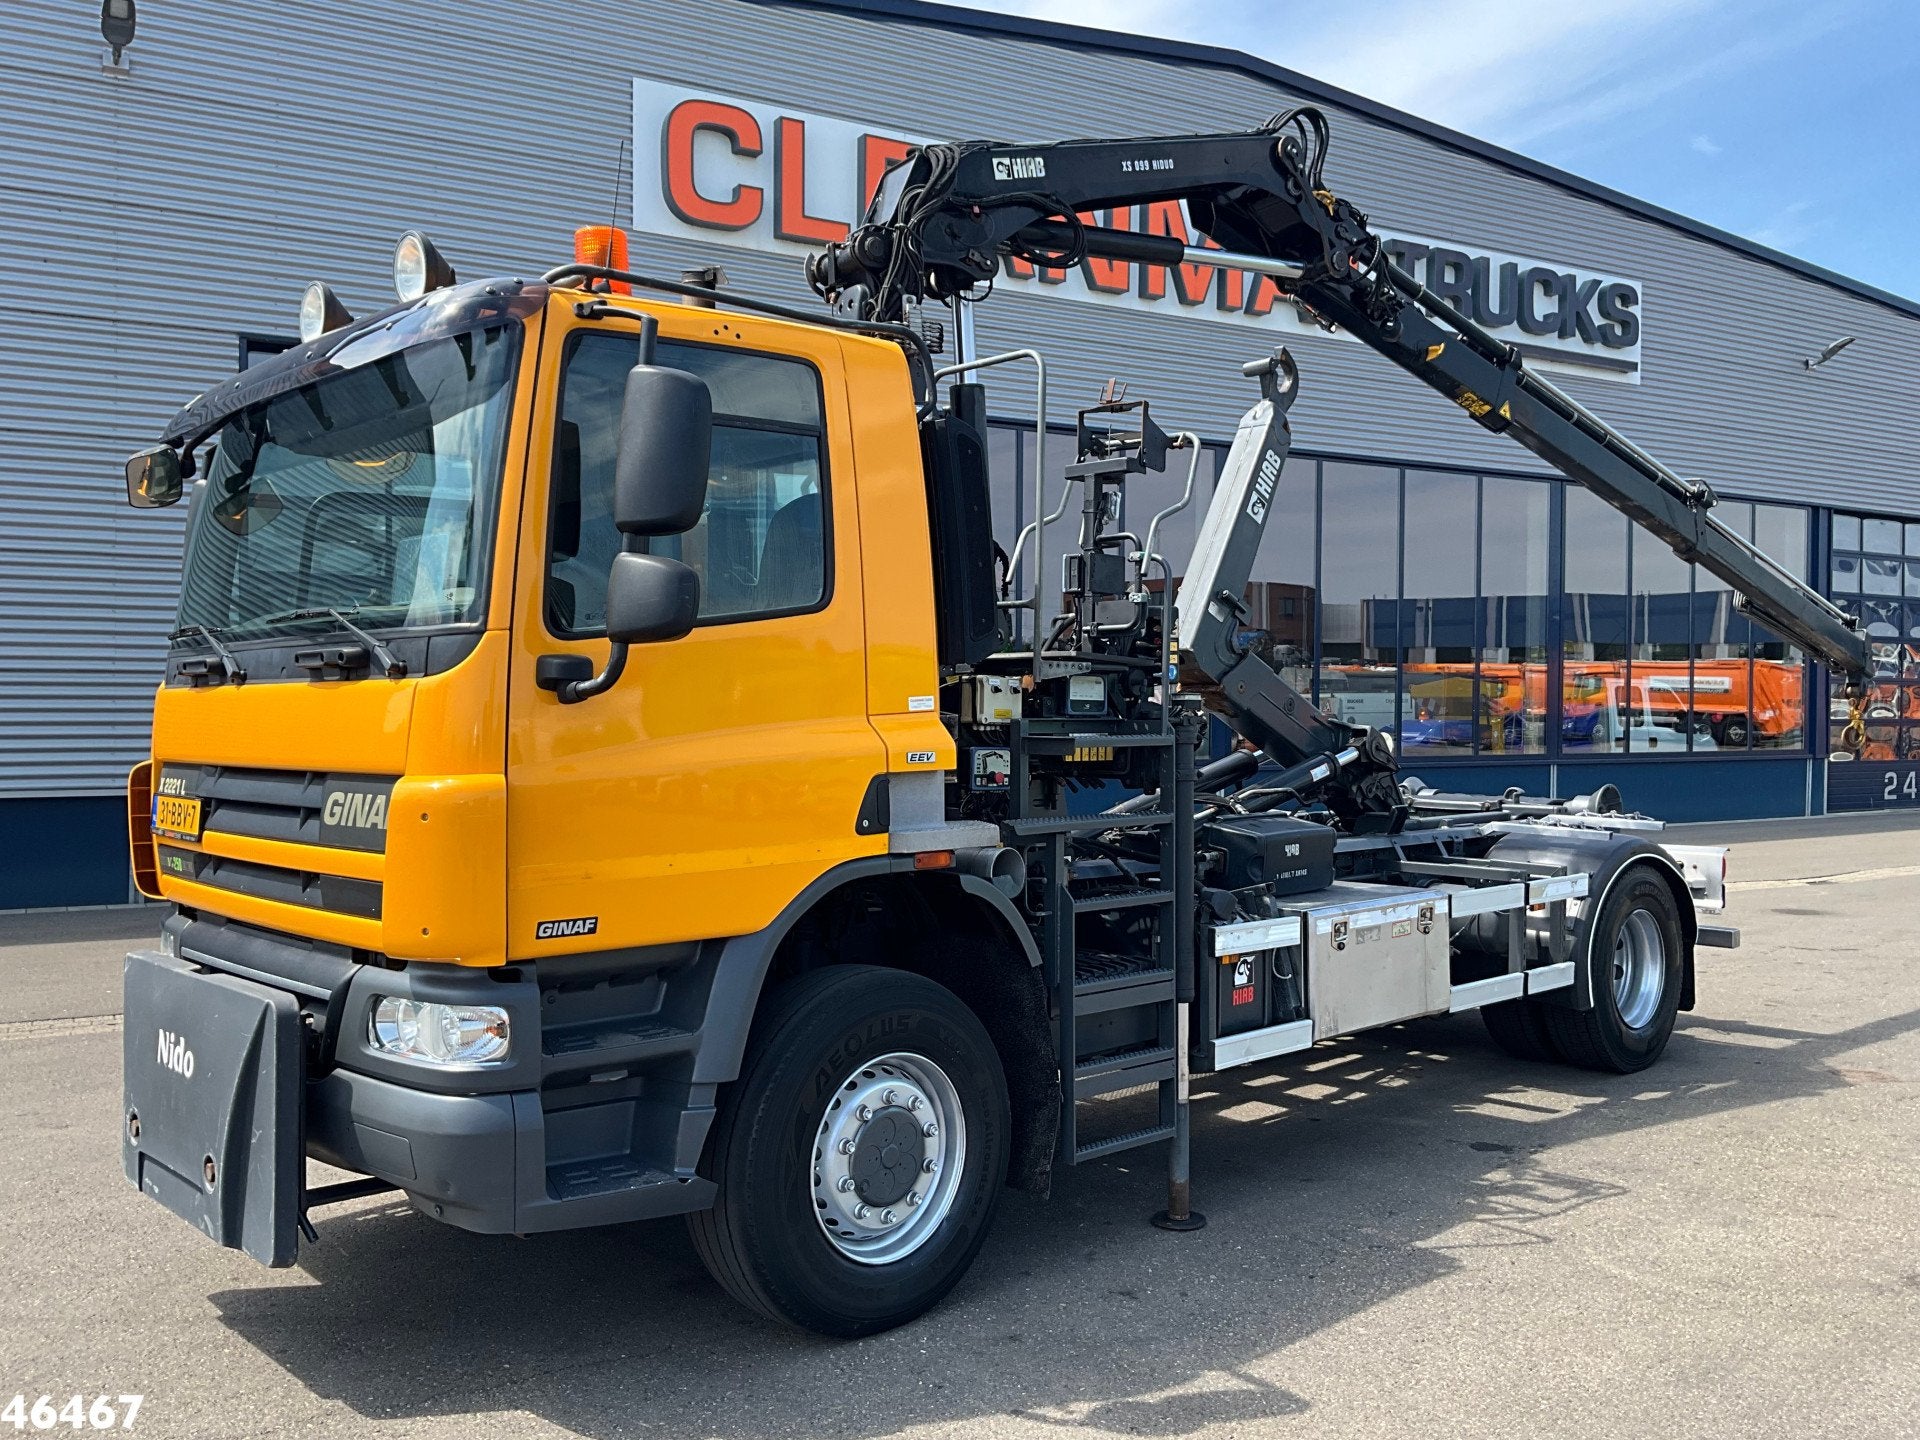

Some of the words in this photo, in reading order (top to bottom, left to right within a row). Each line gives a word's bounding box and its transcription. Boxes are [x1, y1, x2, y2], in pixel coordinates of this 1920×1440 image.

[1011, 157, 1046, 179] HIAB
[1121, 161, 1132, 172] XS
[1134, 159, 1150, 171] 099
[1152, 158, 1175, 171] HIDUO
[1382, 238, 1640, 350] TRUCKS
[1255, 449, 1281, 500] HIAB
[909, 752, 934, 762] EEV
[1883, 767, 1918, 800] 24
[160, 800, 197, 829] 31-BBV-7
[323, 791, 389, 830] GINA
[538, 918, 597, 937] GINAF
[1232, 986, 1254, 1006] HIAB
[157, 1028, 195, 1079] Nido
[814, 1014, 912, 1100] AEOLUS
